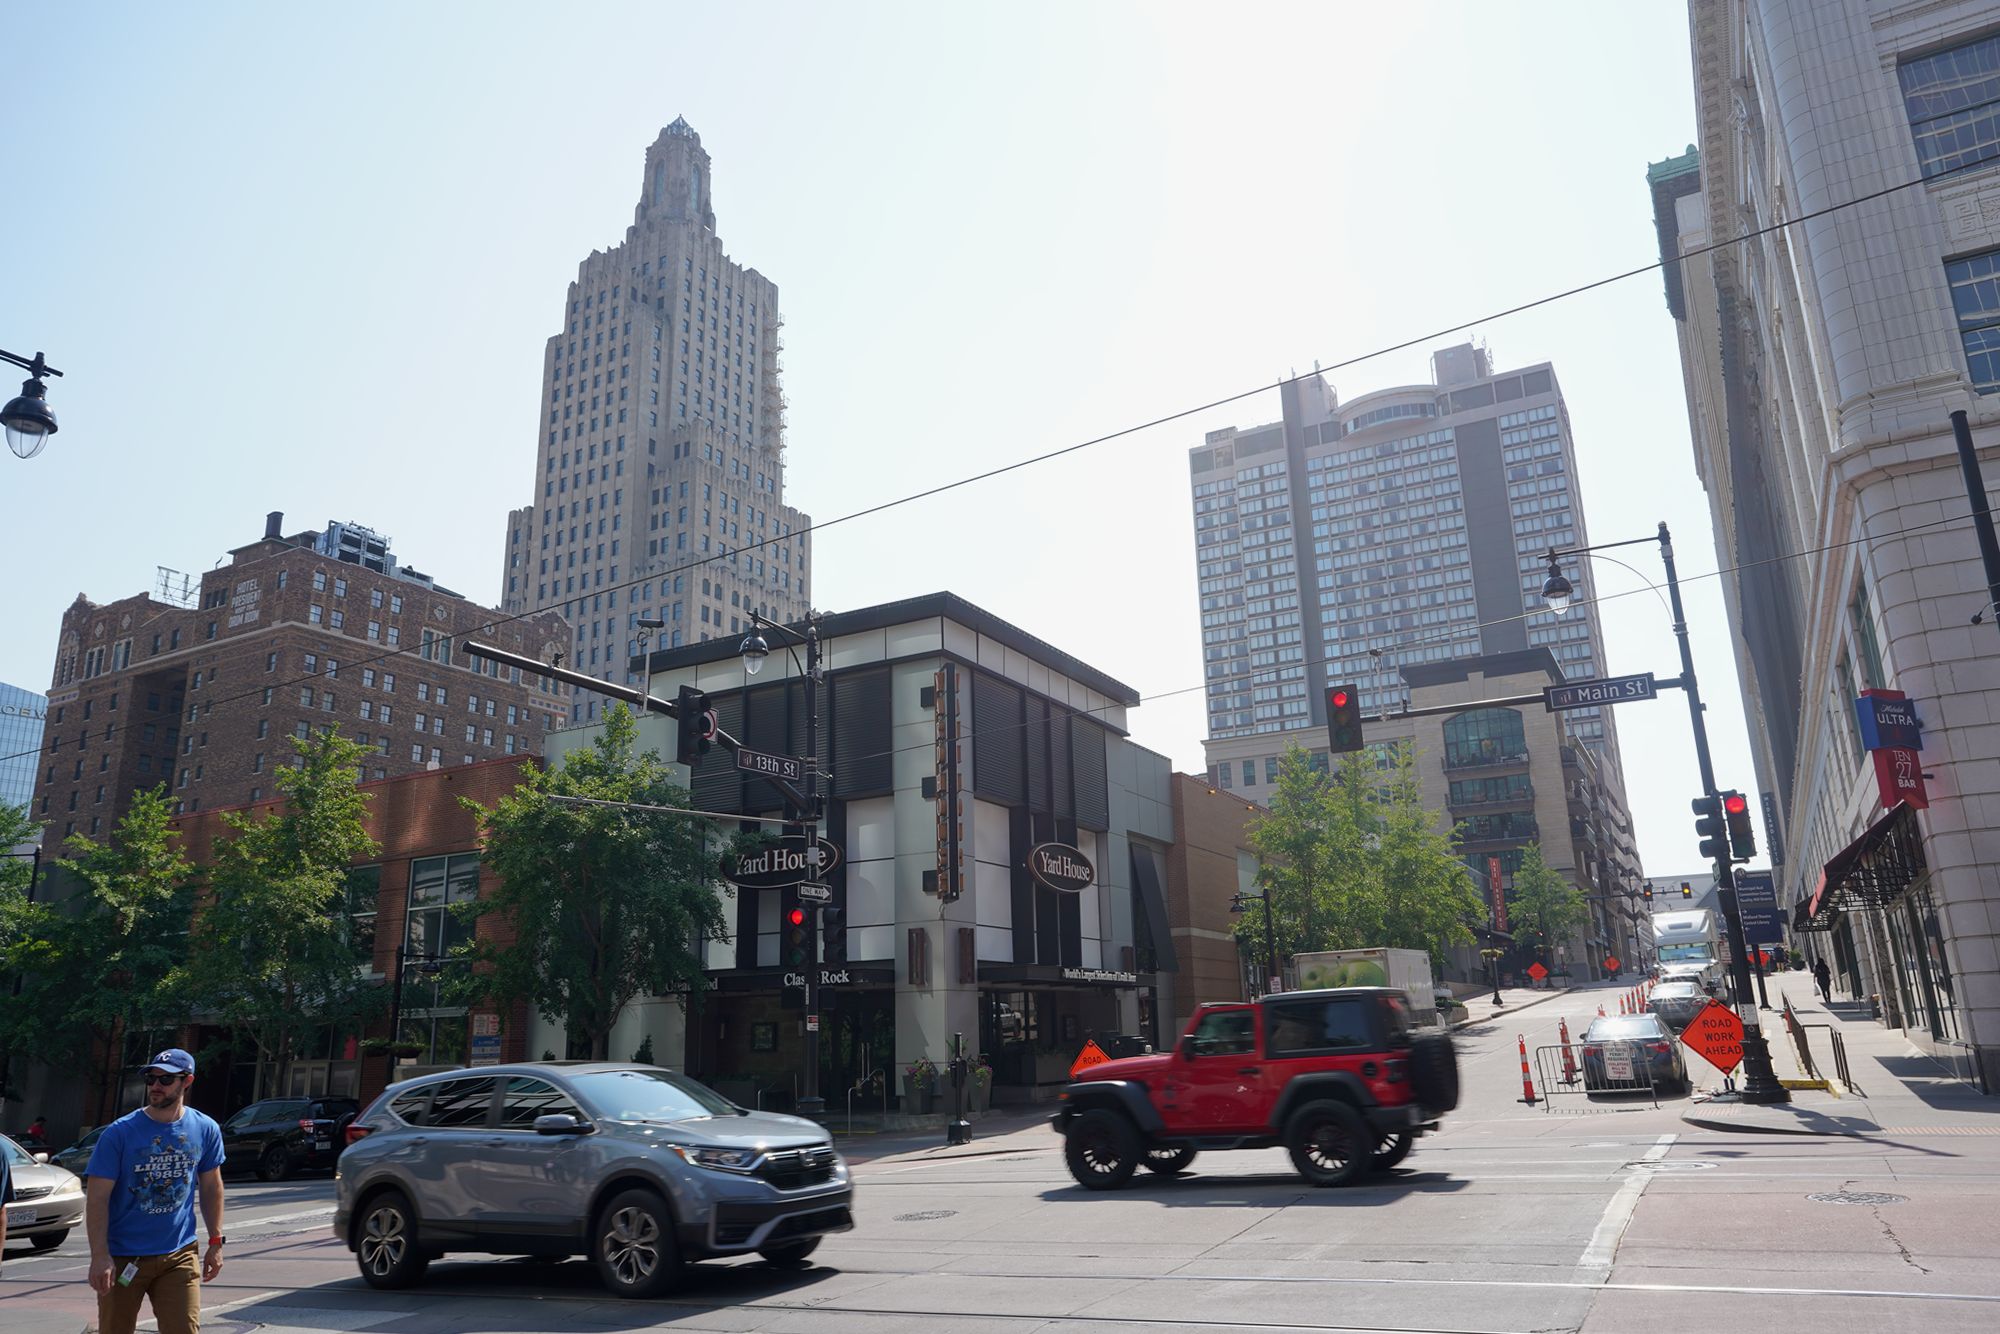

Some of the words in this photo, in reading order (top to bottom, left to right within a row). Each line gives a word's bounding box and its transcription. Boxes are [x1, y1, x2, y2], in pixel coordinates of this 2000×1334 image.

[1578, 685, 1620, 702] Main
[1625, 680, 1645, 696] St
[0, 705, 47, 720] OEW
[1876, 713, 1915, 726] ULTRA
[1892, 750, 1912, 762] TEN
[756, 757, 779, 773] 13th
[783, 762, 796, 777] St
[1895, 762, 1912, 779] 27
[1898, 779, 1917, 789] BAR
[772, 848, 826, 872] Houe
[1040, 851, 1062, 875] Yard
[1063, 856, 1091, 881] House
[802, 886, 813, 895] ONE
[814, 887, 825, 896] WAY
[784, 972, 820, 987] Clas
[821, 970, 850, 985] Rock
[1702, 1019, 1732, 1028] ROAD
[1704, 1033, 1735, 1042] WORK
[1705, 1045, 1742, 1055] AHEAD
[1083, 1057, 1101, 1065] ROAD
[149, 1154, 190, 1163] PARTY
[134, 1163, 172, 1173] LIKE
